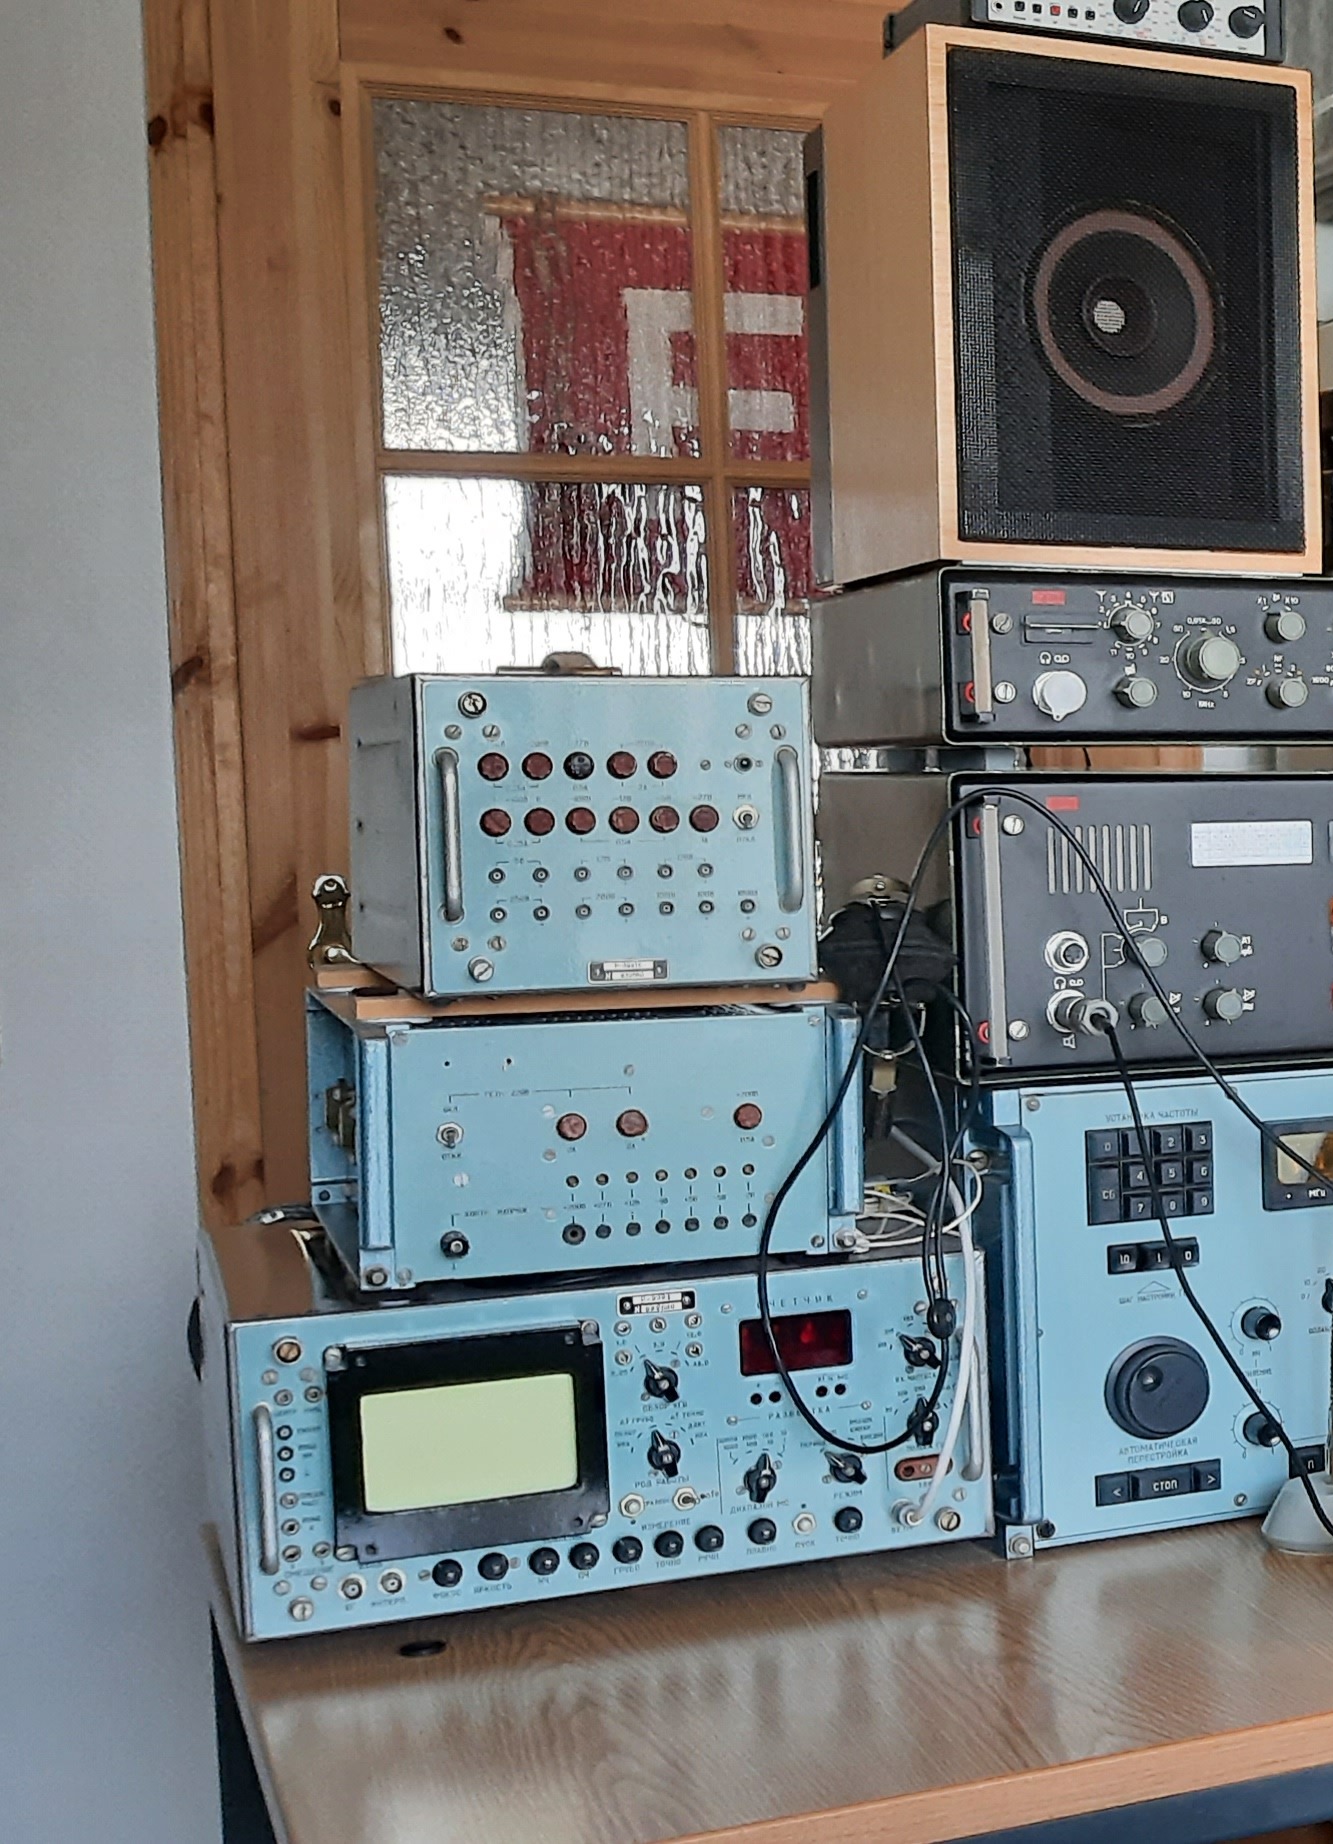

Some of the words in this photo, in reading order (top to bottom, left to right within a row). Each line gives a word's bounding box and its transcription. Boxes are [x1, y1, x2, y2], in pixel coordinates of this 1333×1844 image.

[1105, 1109, 1156, 1123] УСТАНКА
[1157, 1108, 1199, 1119] ЧАСТОТЫ
[1118, 1437, 1198, 1456] АВТОМАТИЧЕСКАЯ
[1128, 1448, 1189, 1464] ПЕРЕСТРОЙКА
[833, 1489, 863, 1499] РЕЖИМ
[729, 1502, 774, 1515] ДИАПАЗОН
